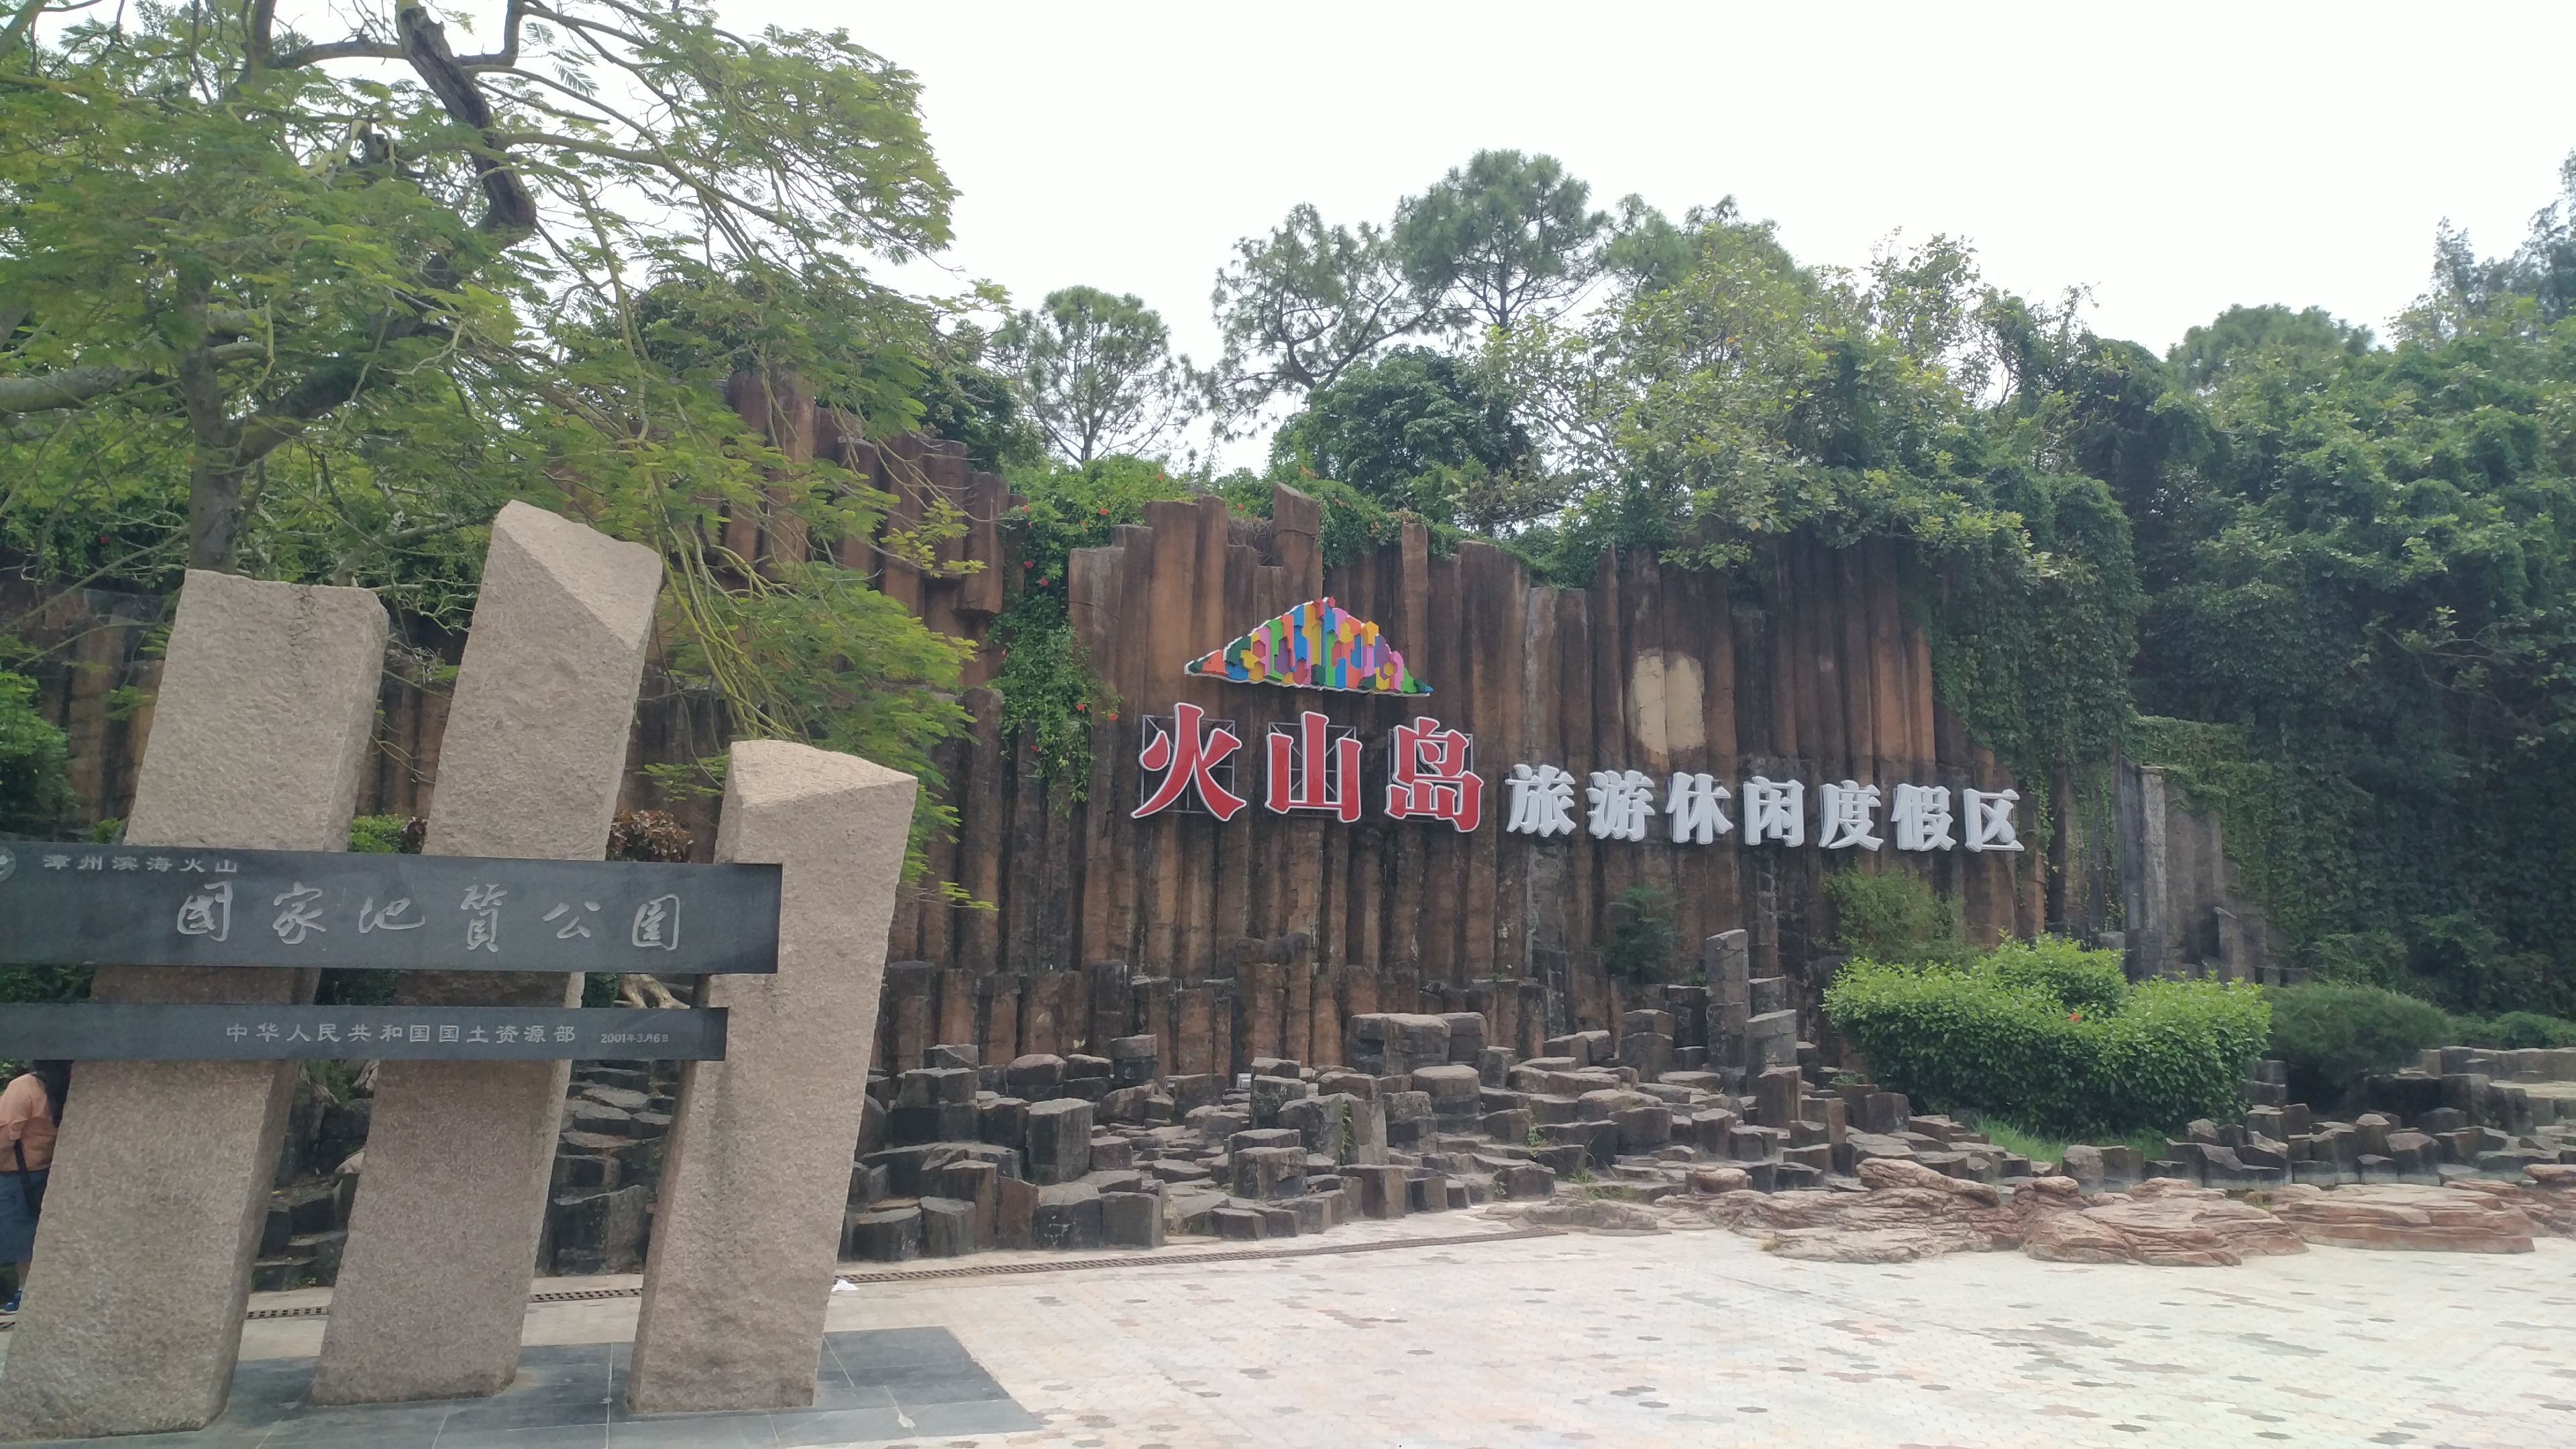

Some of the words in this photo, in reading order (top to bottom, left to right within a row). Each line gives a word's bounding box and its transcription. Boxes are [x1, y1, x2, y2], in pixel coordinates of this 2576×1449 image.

[1131, 702, 1484, 833] 火山岛
[1505, 763, 2025, 853] 旅游休闲度假区
[43, 854, 237, 873] 漳州滨海火山
[227, 1022, 576, 1044] 中华人民共和国国土资源部
[600, 1033, 669, 1044] 2001年3月6日
